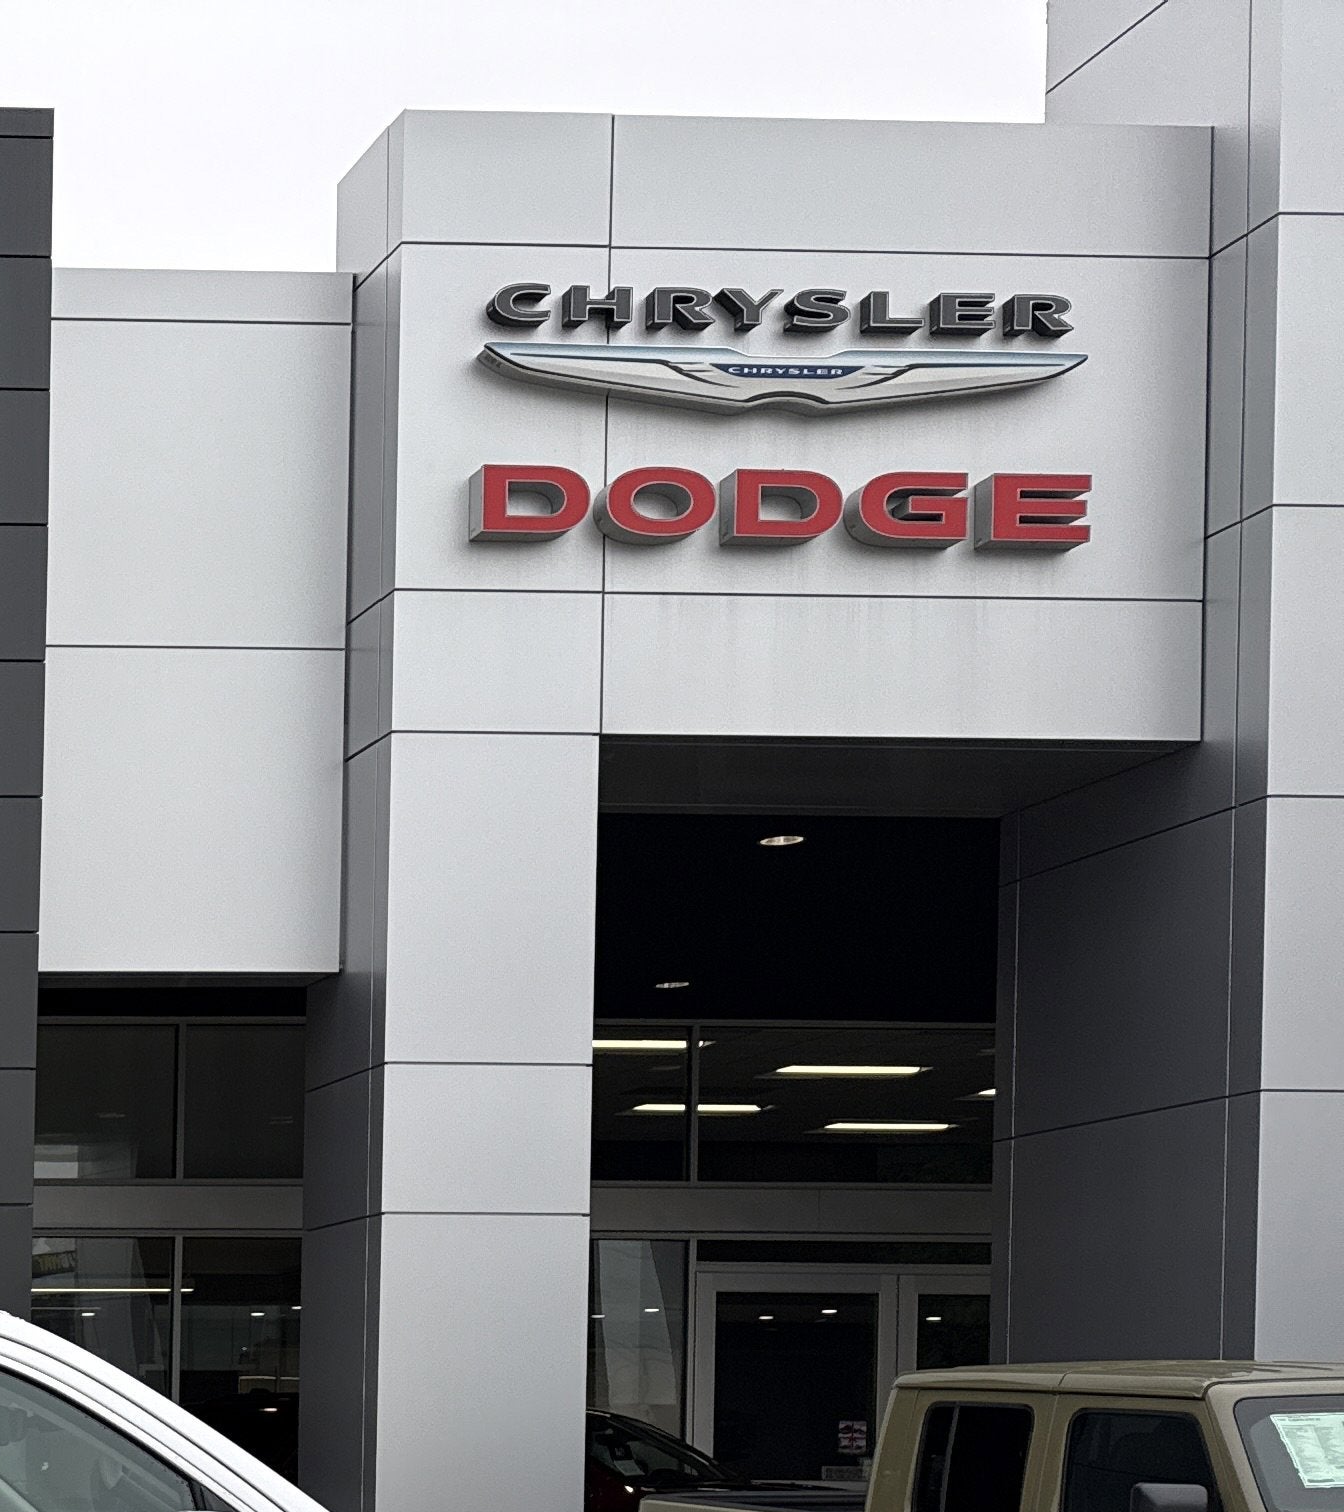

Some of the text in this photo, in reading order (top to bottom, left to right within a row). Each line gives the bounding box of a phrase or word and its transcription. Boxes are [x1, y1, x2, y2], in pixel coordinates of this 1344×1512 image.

[485, 282, 1075, 338] CHRYSLER
[726, 364, 845, 379] CHRYSLER
[468, 464, 1094, 550] DODGE
